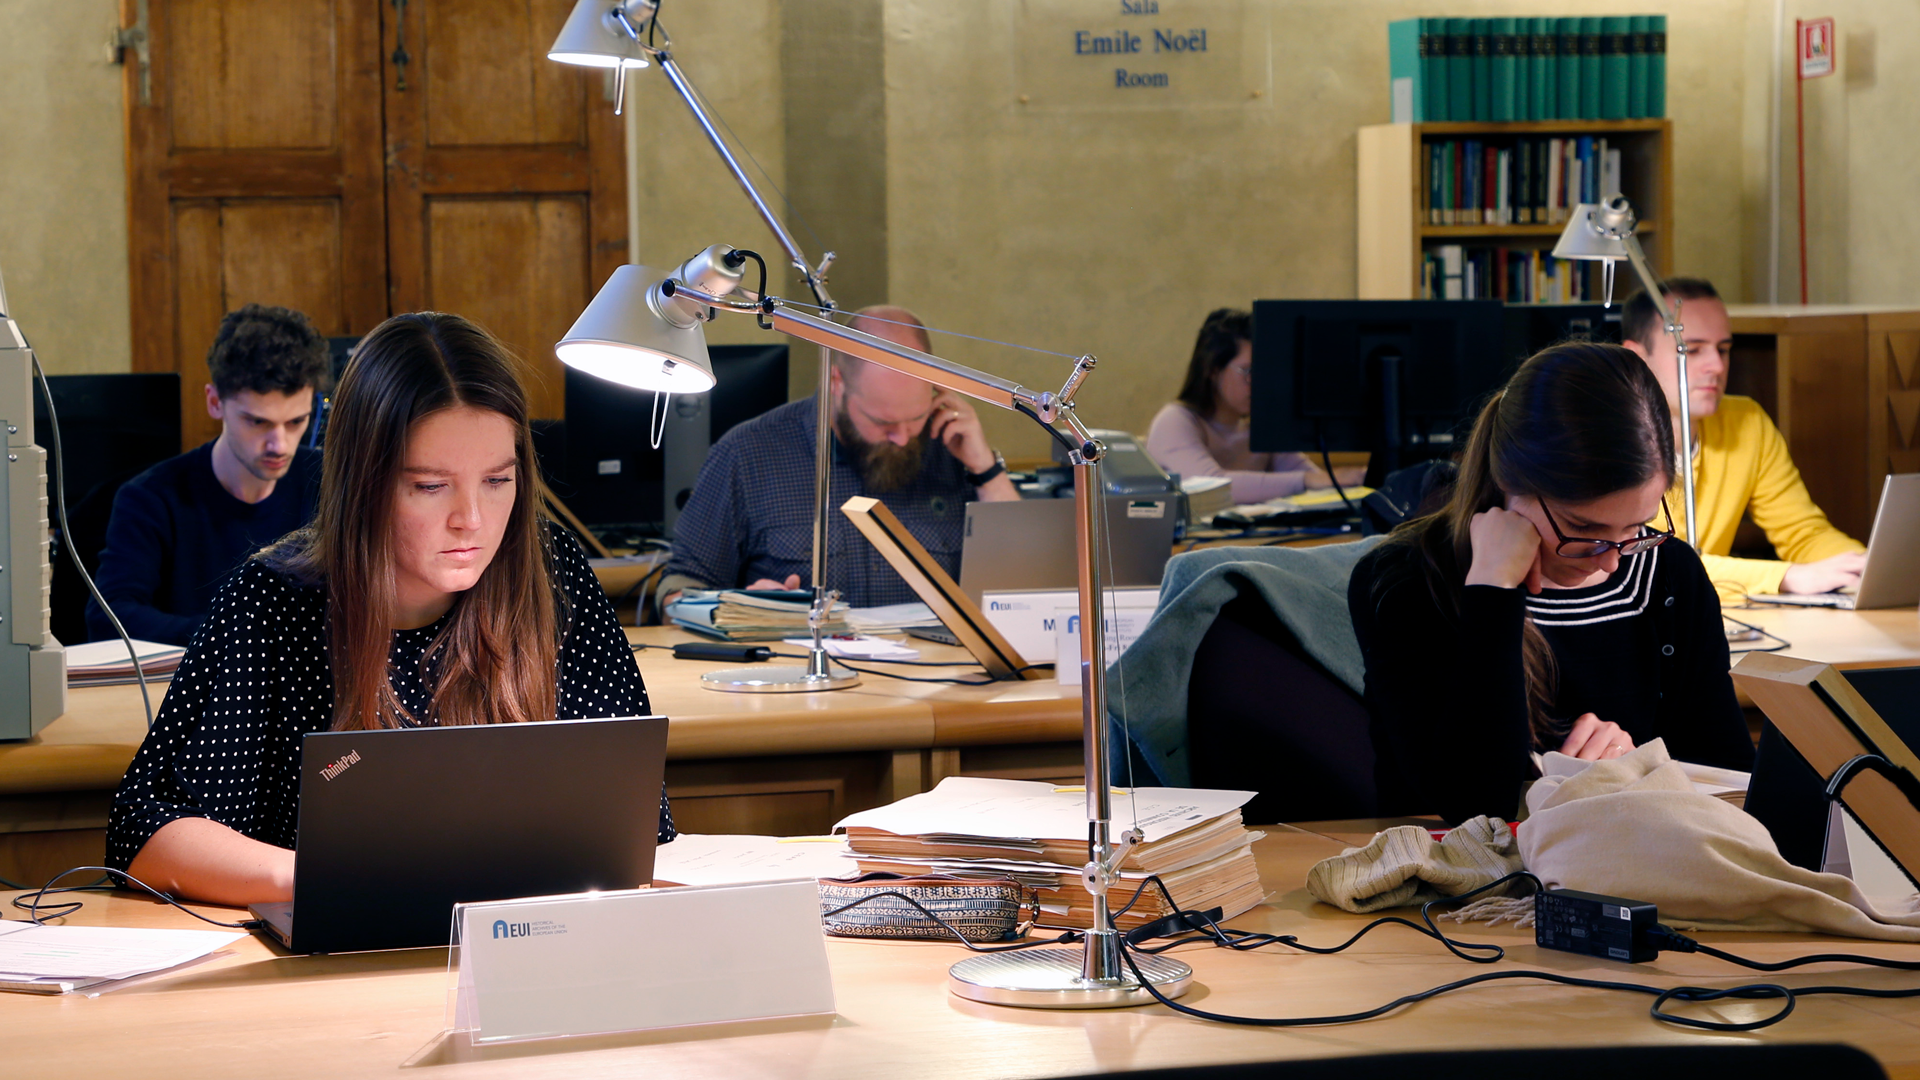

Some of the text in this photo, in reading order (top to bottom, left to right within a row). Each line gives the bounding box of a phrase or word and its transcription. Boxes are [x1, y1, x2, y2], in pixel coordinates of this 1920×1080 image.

[1122, 0, 1159, 15] Sala
[1075, 29, 1208, 55] Emile Noël
[1115, 68, 1169, 88] Room
[319, 749, 361, 781] ThinkPad
[510, 923, 530, 938] EUI
[1610, 949, 1628, 957] Lenovo
